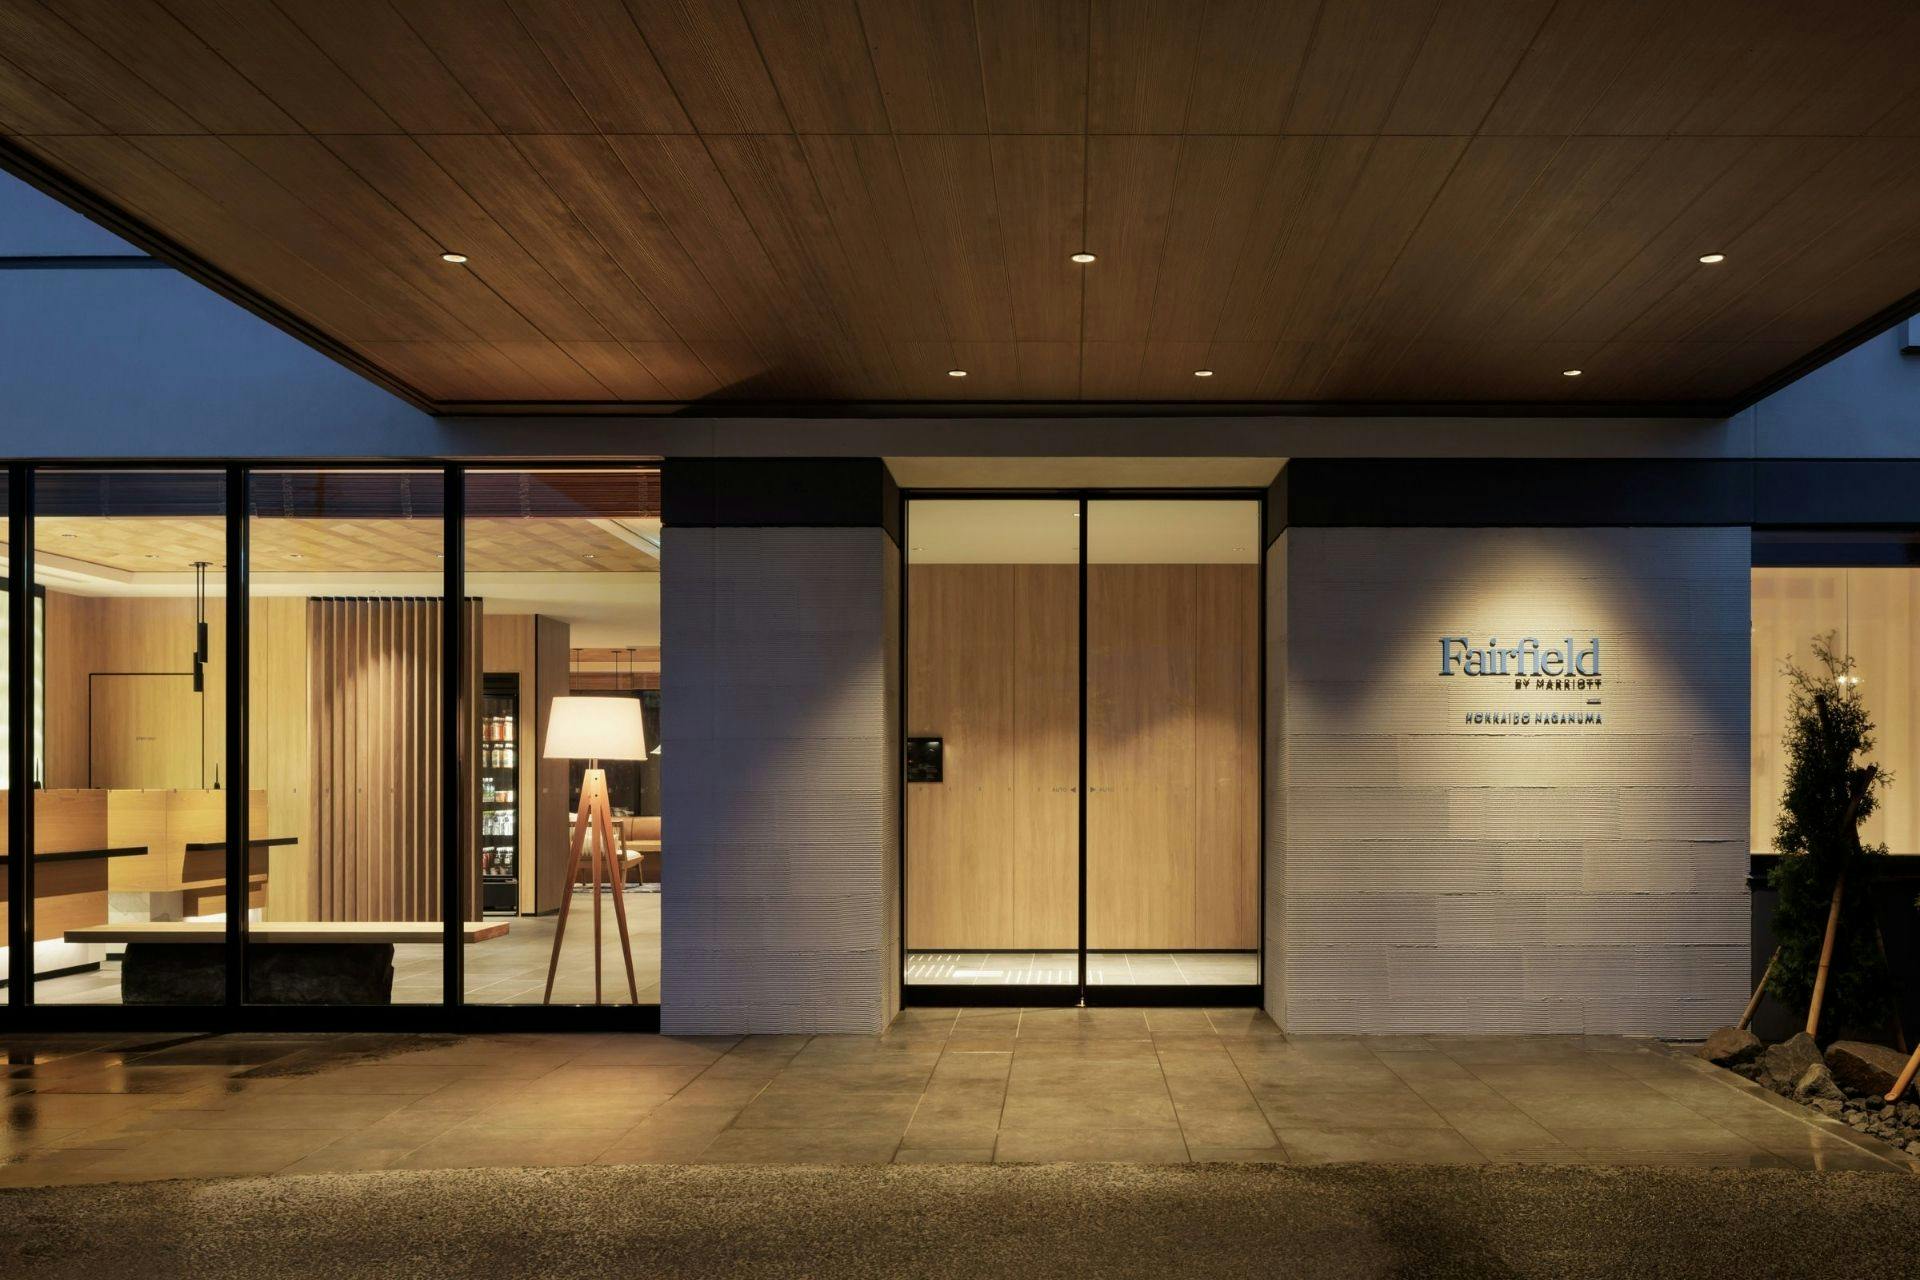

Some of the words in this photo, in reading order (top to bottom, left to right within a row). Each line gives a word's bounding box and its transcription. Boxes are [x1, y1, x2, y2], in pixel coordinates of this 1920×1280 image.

[1439, 637, 1601, 677] Fairfield
[1515, 678, 1530, 690] BY
[1536, 678, 1602, 690] MARRIOTT
[1465, 712, 1530, 724] HOKKAIDO
[1535, 712, 1602, 724] NAGANUMA
